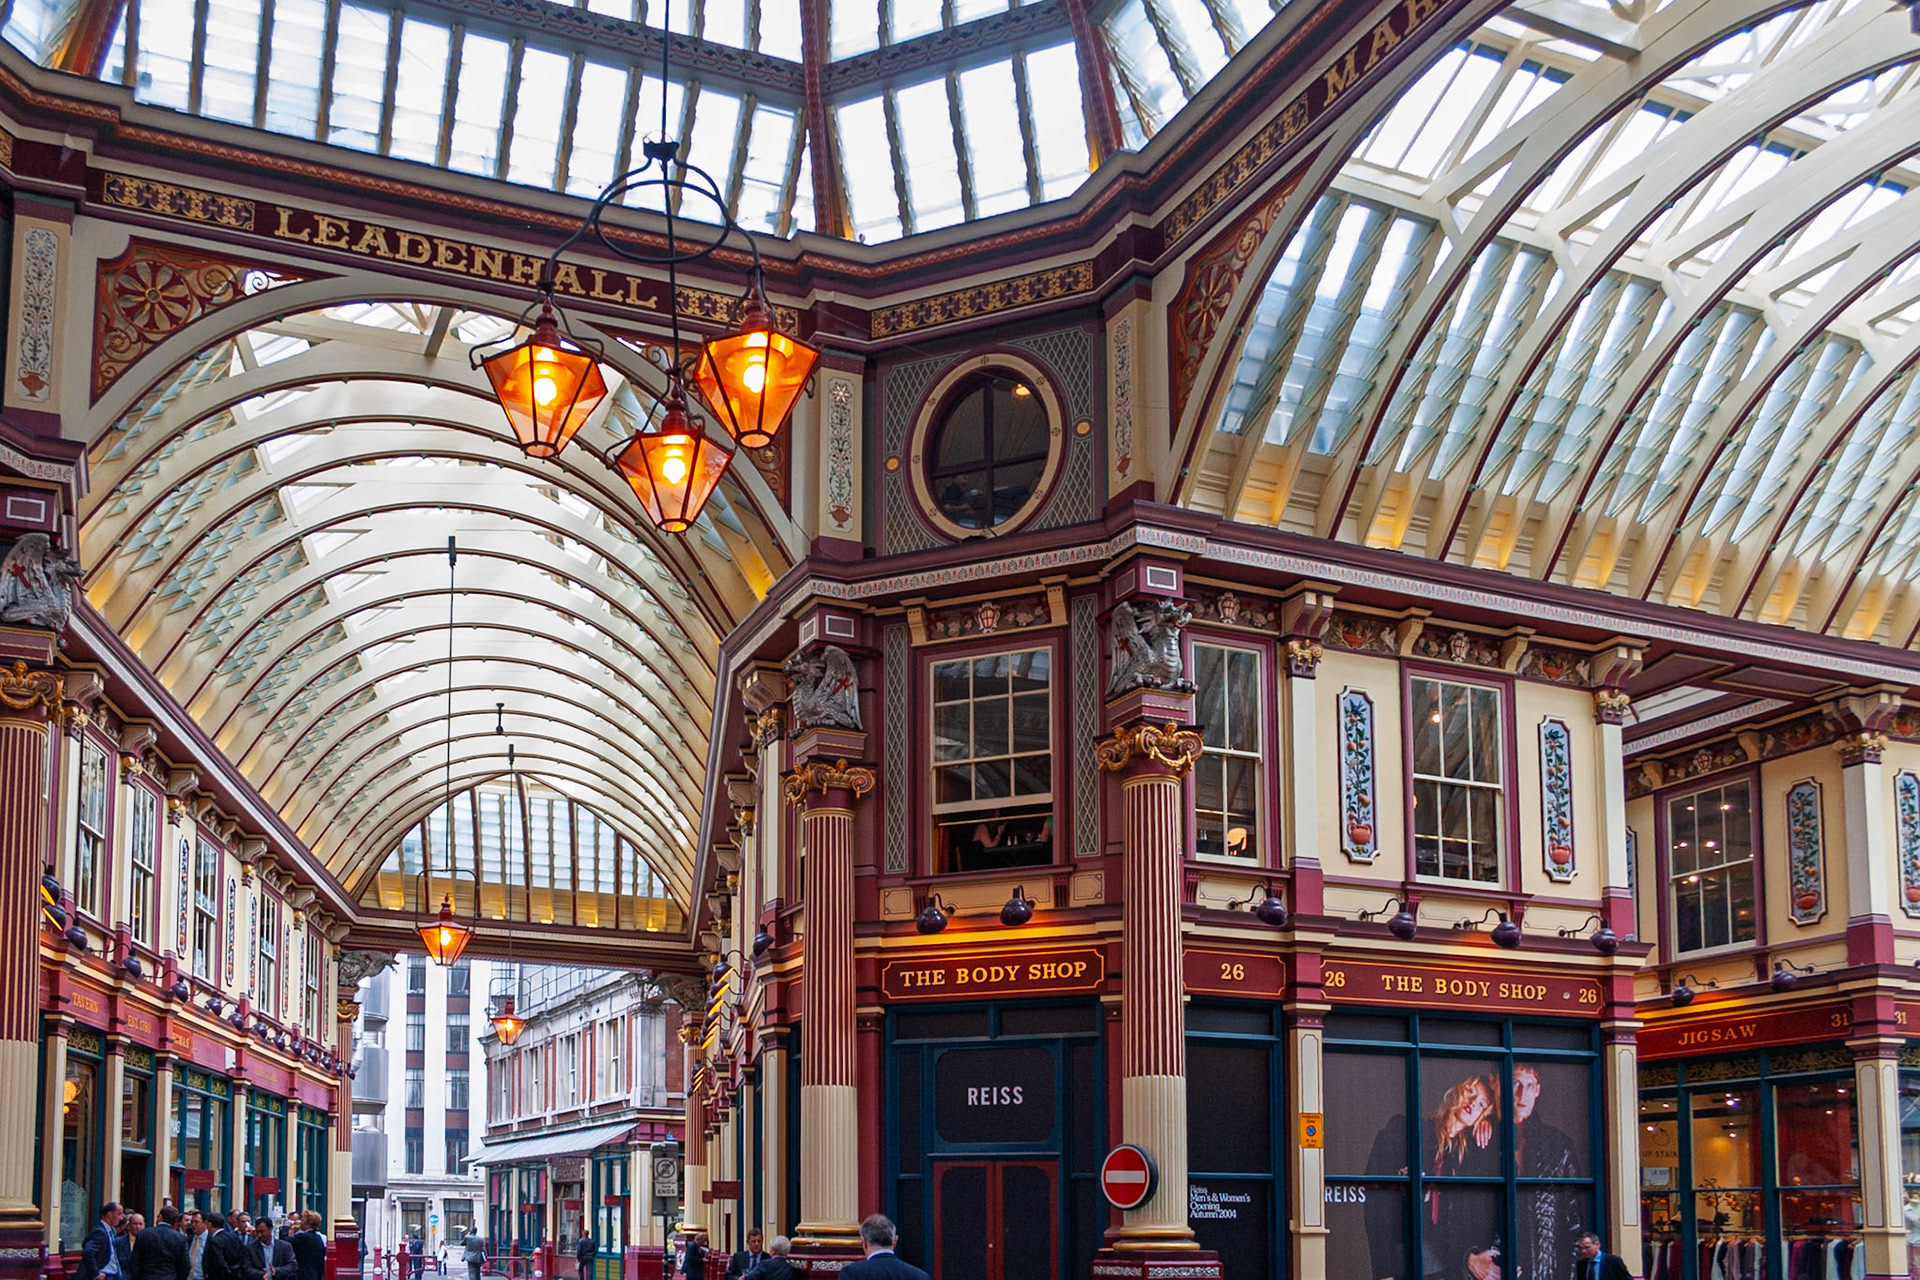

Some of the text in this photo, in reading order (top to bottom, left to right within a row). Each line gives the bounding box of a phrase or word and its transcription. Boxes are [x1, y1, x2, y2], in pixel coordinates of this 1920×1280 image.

[1323, 0, 1440, 107] MAR
[274, 207, 658, 309] LEADENHALL
[900, 961, 1087, 987] THE BODY SHOP
[1220, 963, 1245, 981] 26
[1324, 970, 1346, 988] 26
[1381, 974, 1548, 1001] THE BODY SHOP
[1578, 987, 1598, 1004] 26
[72, 992, 99, 1014] TAVERN
[1831, 1013, 1850, 1028] 31
[1678, 1024, 1757, 1046] JIGSAW
[967, 1086, 1024, 1106] REISS
[1190, 1184, 1208, 1194] Reiss
[1190, 1193, 1251, 1202] Men's & Women's
[1324, 1185, 1367, 1203] REISS
[1190, 1201, 1220, 1212] Opening
[1190, 1209, 1237, 1218] Autumn 2004
